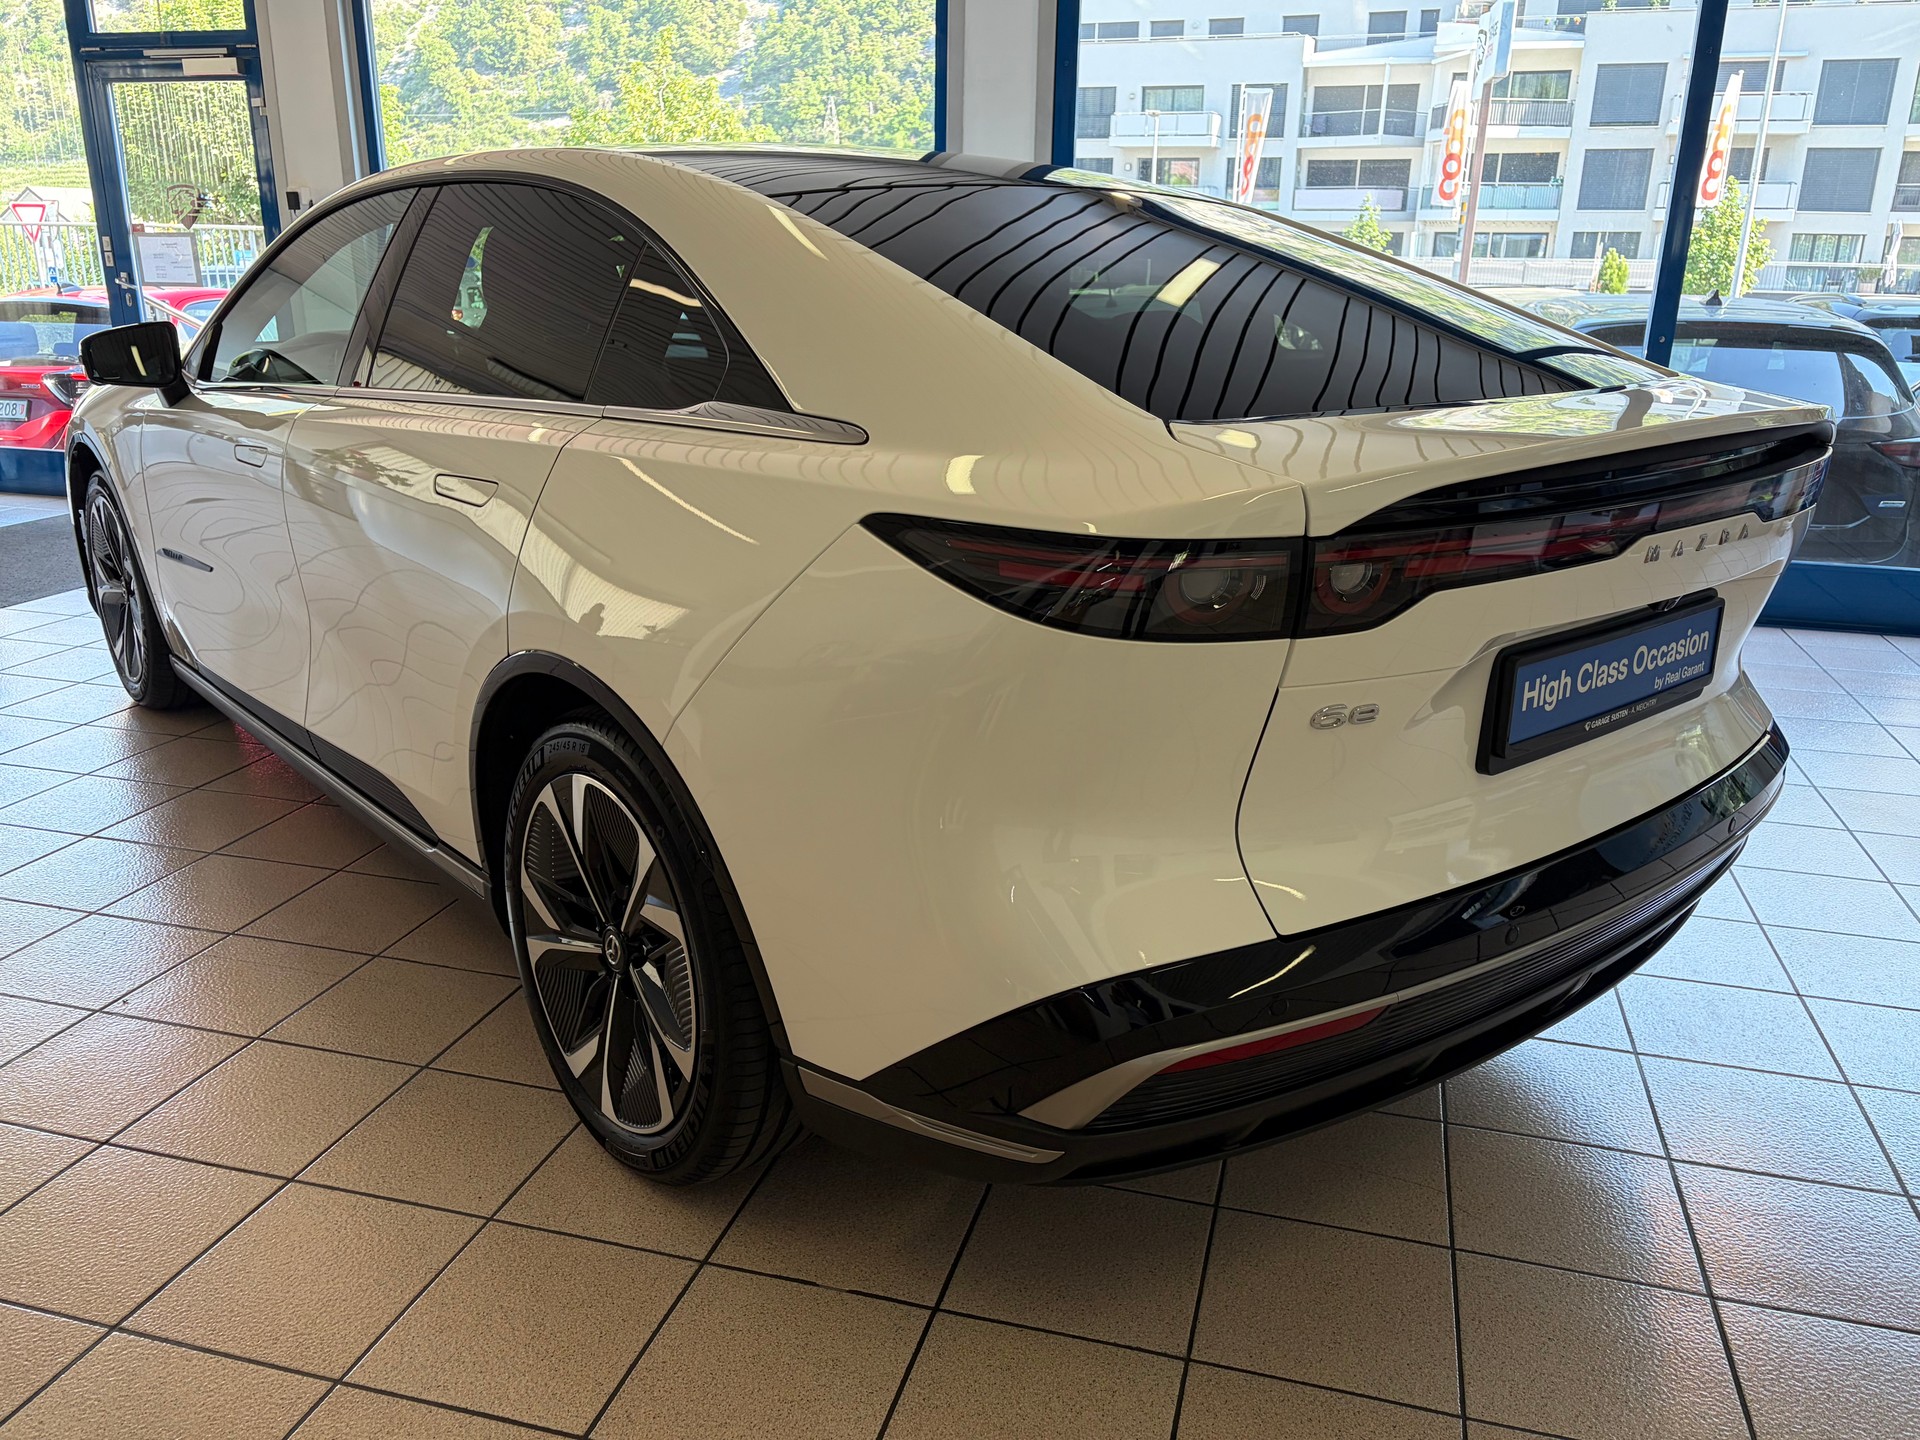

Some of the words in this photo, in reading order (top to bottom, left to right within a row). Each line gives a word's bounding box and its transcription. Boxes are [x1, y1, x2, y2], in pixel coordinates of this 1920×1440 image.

[1643, 523, 1749, 564] MAZDA
[1521, 669, 1572, 712] High
[1576, 657, 1628, 693] Class
[1632, 629, 1710, 675] Occasion
[1654, 675, 1665, 690] by
[1665, 668, 1681, 686] Real
[1681, 660, 1705, 679] Garant
[1310, 703, 1380, 730] 6e
[1590, 715, 1611, 729] GARAGE
[1611, 708, 1629, 722] SUSTEN
[548, 740, 571, 754] 245/45
[578, 743, 587, 753] 19
